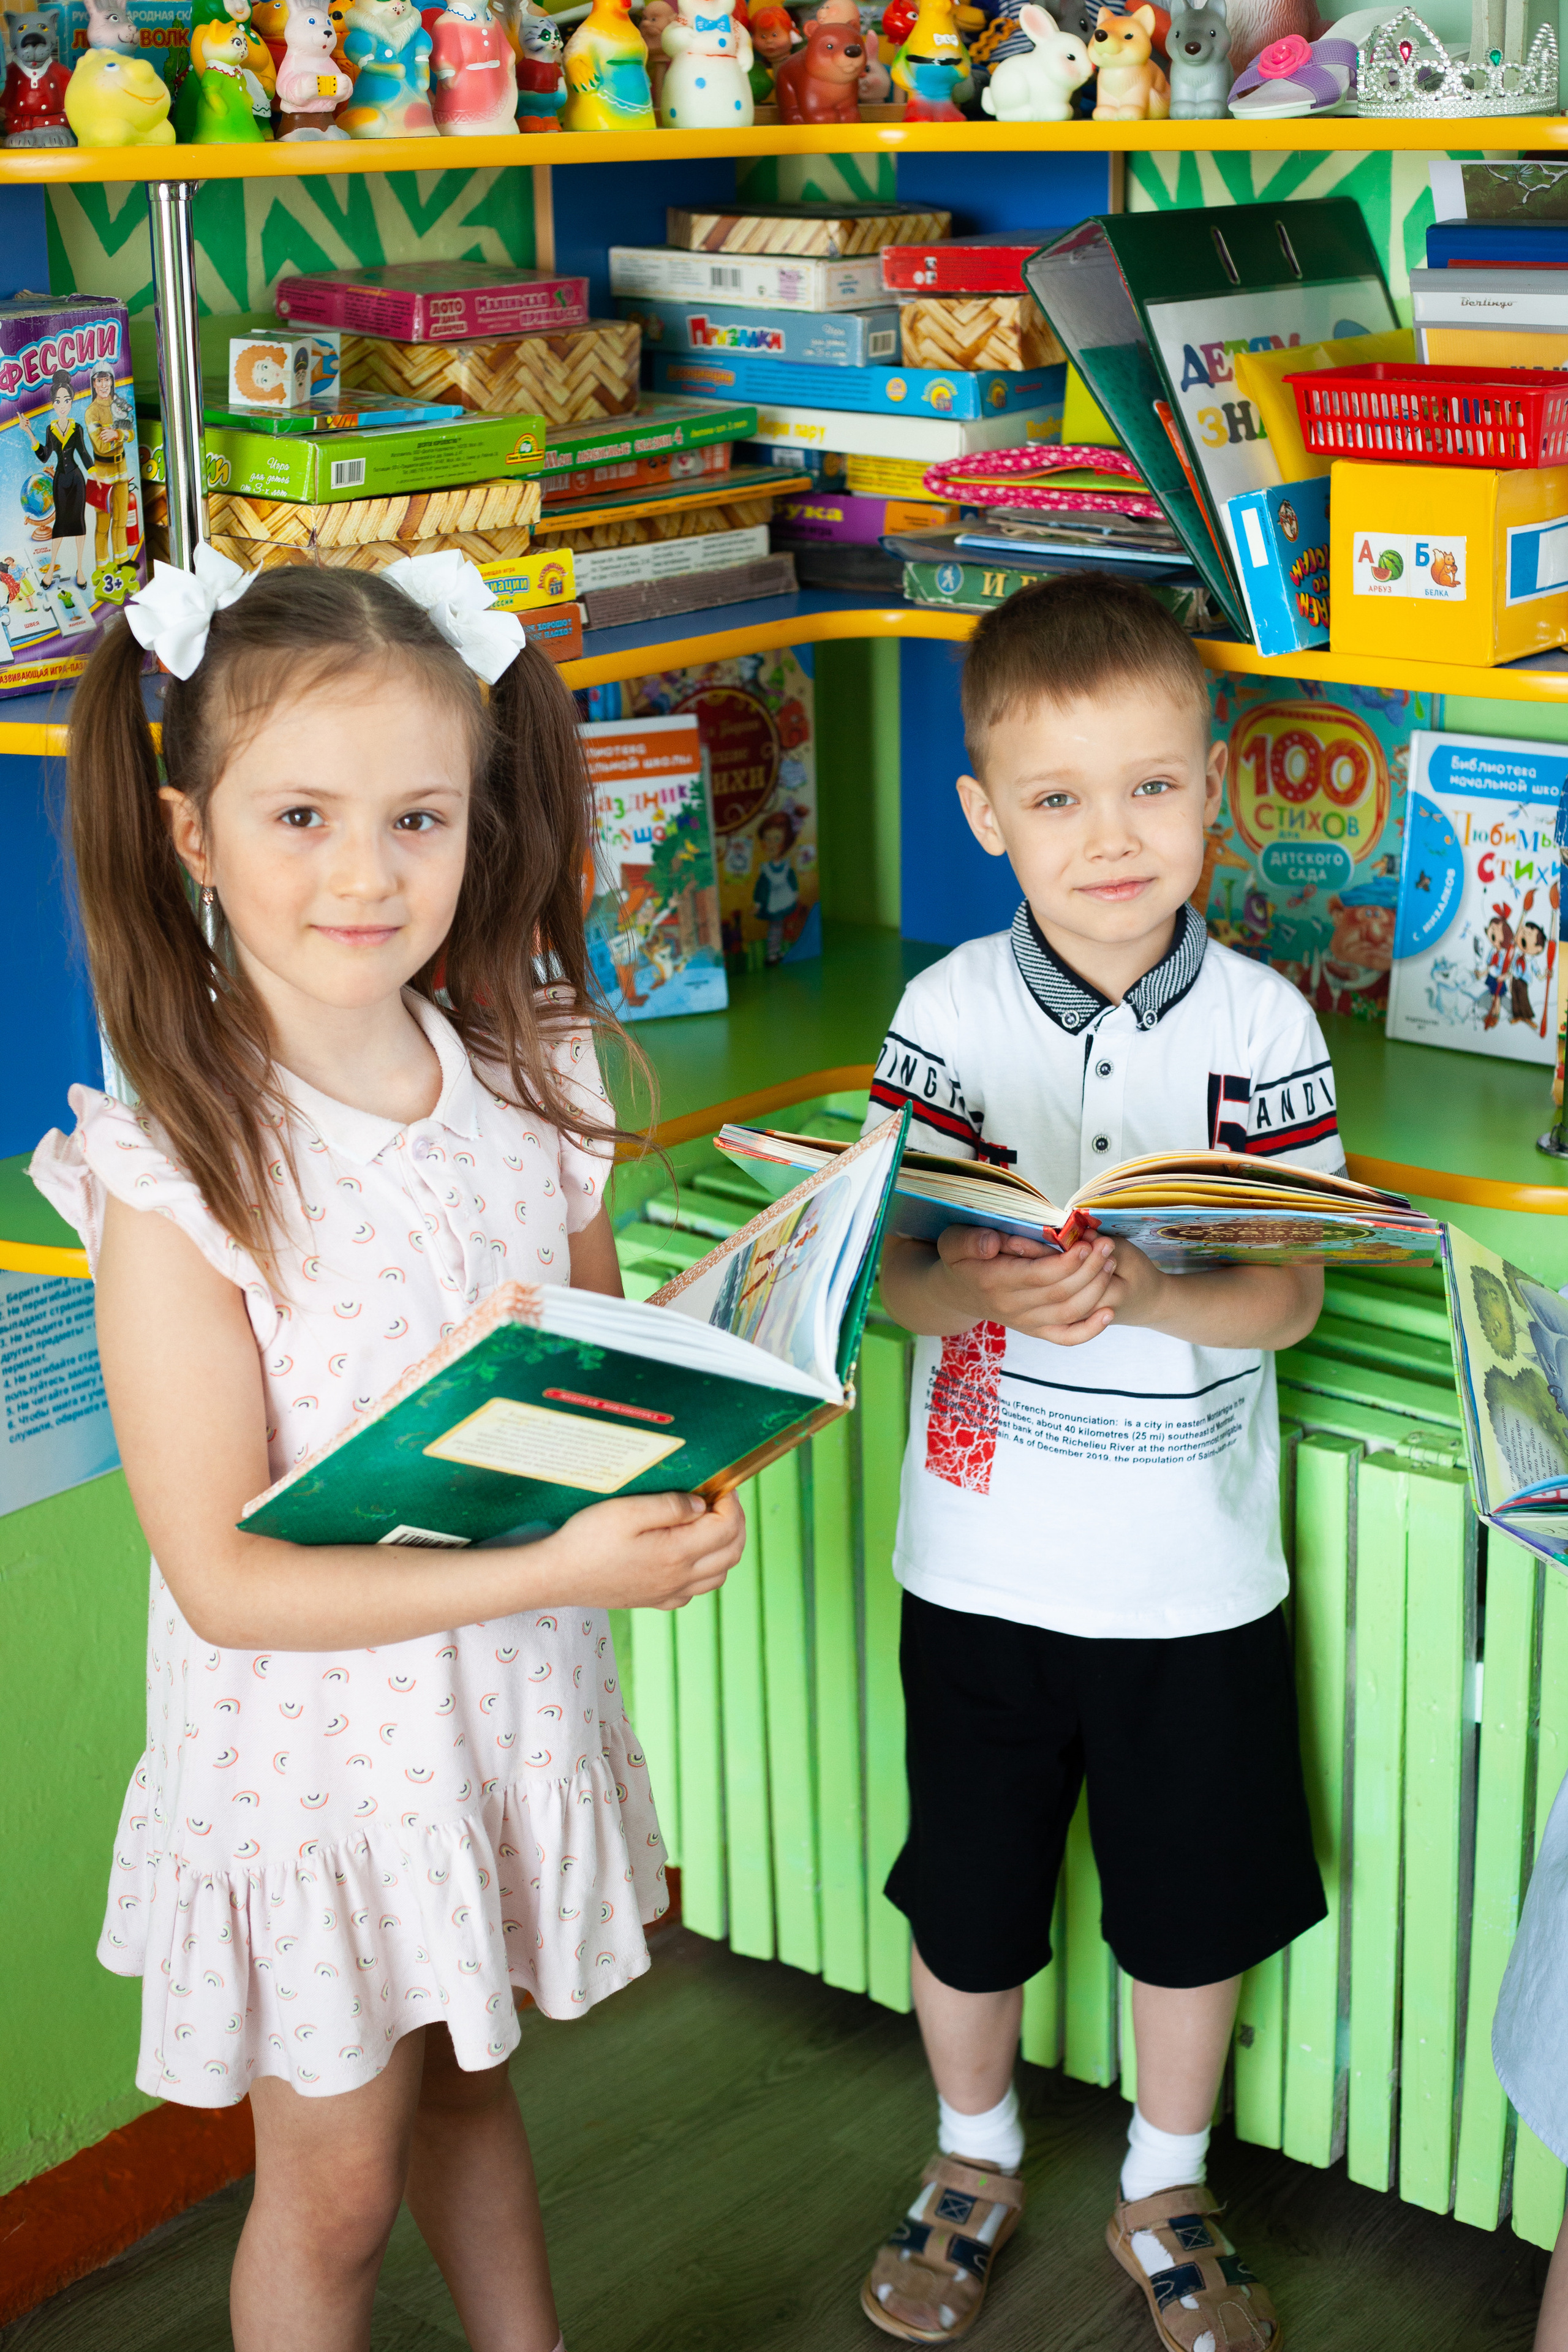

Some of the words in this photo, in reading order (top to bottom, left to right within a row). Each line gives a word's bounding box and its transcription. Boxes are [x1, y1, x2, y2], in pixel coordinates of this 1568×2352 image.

[126, 10, 173, 21] АРОДНАЯ
[139, 28, 190, 48] ВОЛК
[1461, 296, 1518, 309] Berlingo
[673, 426, 684, 445] 4
[267, 457, 290, 473] Игра
[1358, 540, 1374, 564] А
[1415, 543, 1430, 567] Б
[104, 575, 123, 593] 3+
[1368, 584, 1392, 594] АРБУЗ
[1425, 588, 1449, 598] БЕЛКА
[24, 620, 40, 629] ШВЕЯ
[50, 662, 88, 677] ИГРА-ПАЗ
[1241, 729, 1372, 809] 100
[1451, 755, 1537, 778] Библиотека
[1450, 775, 1528, 793] начальной
[1532, 785, 1561, 796] шко
[1254, 802, 1360, 840] СТИХОВ
[1270, 851, 1344, 867] ДЕТСКОГО
[1288, 867, 1327, 881] САДА
[78, 1349, 99, 1362] стра
[937, 1395, 965, 1412] situated
[966, 1408, 976, 1417] on
[977, 1411, 990, 1422] the
[991, 1418, 1011, 1429] west
[1012, 1422, 1033, 1434] bank
[1046, 1431, 1059, 1442] the
[1063, 1436, 1107, 1450] Richelieu
[1110, 1442, 1135, 1452] River
[1150, 1444, 1165, 1453] the
[1167, 1436, 1219, 1452] northernmost
[1001, 1407, 1035, 1426] Quebec,
[1036, 1419, 1062, 1432] about
[1065, 1425, 1076, 1434] 40
[1079, 1427, 1129, 1439] kilometres
[1132, 1431, 1147, 1441] (25
[1150, 1432, 1165, 1442] mi)
[1167, 1427, 1209, 1441] southeast
[1012, 1400, 1046, 1416] (French
[1049, 1410, 1118, 1427] pronunciation:
[1125, 1419, 1133, 1428] is
[1144, 1420, 1162, 1431] city
[1165, 1420, 1174, 1428] in
[1176, 1418, 1206, 1428] eastern
[950, 1413, 967, 1424] Lake
[1013, 1434, 1023, 1444] As
[1037, 1441, 1084, 1458] December
[1133, 1455, 1184, 1464] population
[1186, 1453, 1196, 1462] of
[1515, 1419, 1526, 1474] крокодильчик
